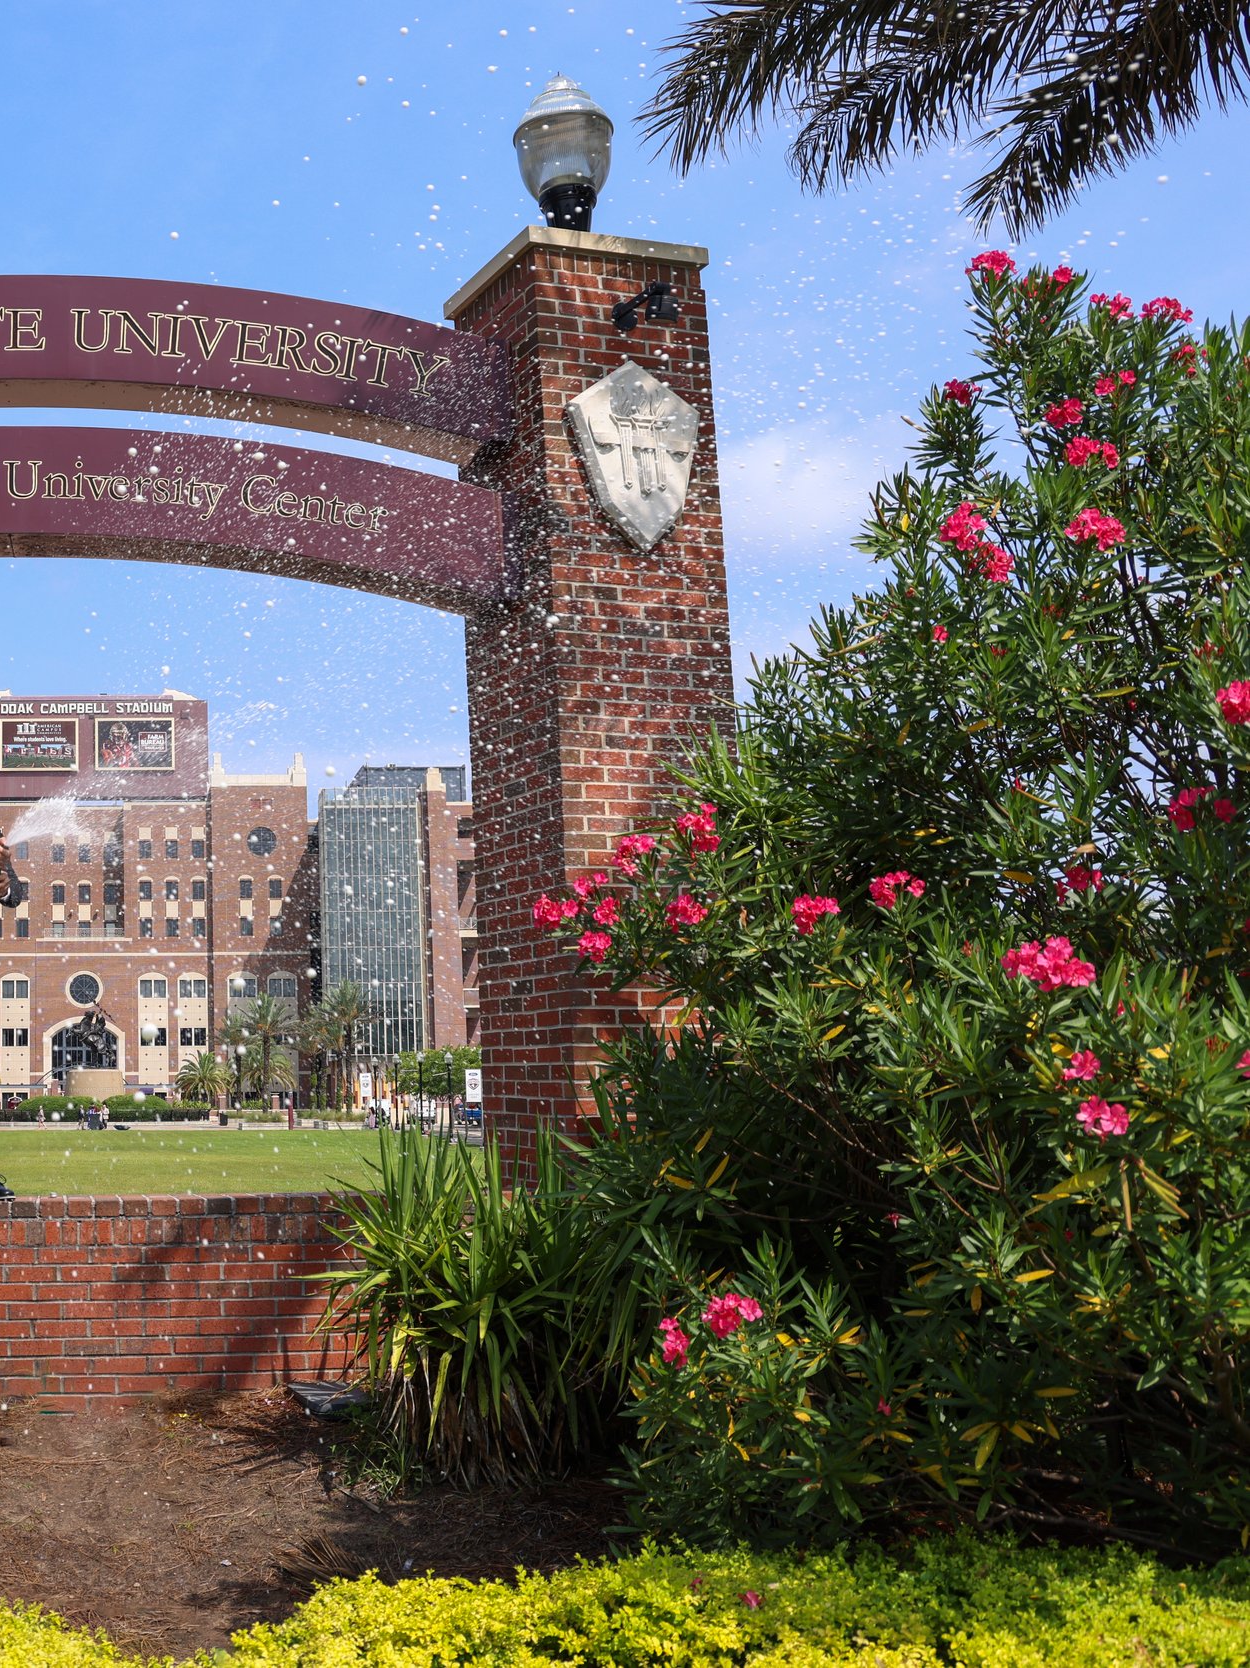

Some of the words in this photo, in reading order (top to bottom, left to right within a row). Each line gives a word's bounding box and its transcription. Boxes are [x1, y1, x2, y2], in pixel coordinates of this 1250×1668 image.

[69, 308, 451, 398] UNIVERSITY
[2, 459, 227, 521] University
[240, 474, 390, 535] Center
[0, 703, 35, 714] DOAK
[40, 703, 109, 714] CAMPBELL
[116, 702, 173, 713] STADIUM
